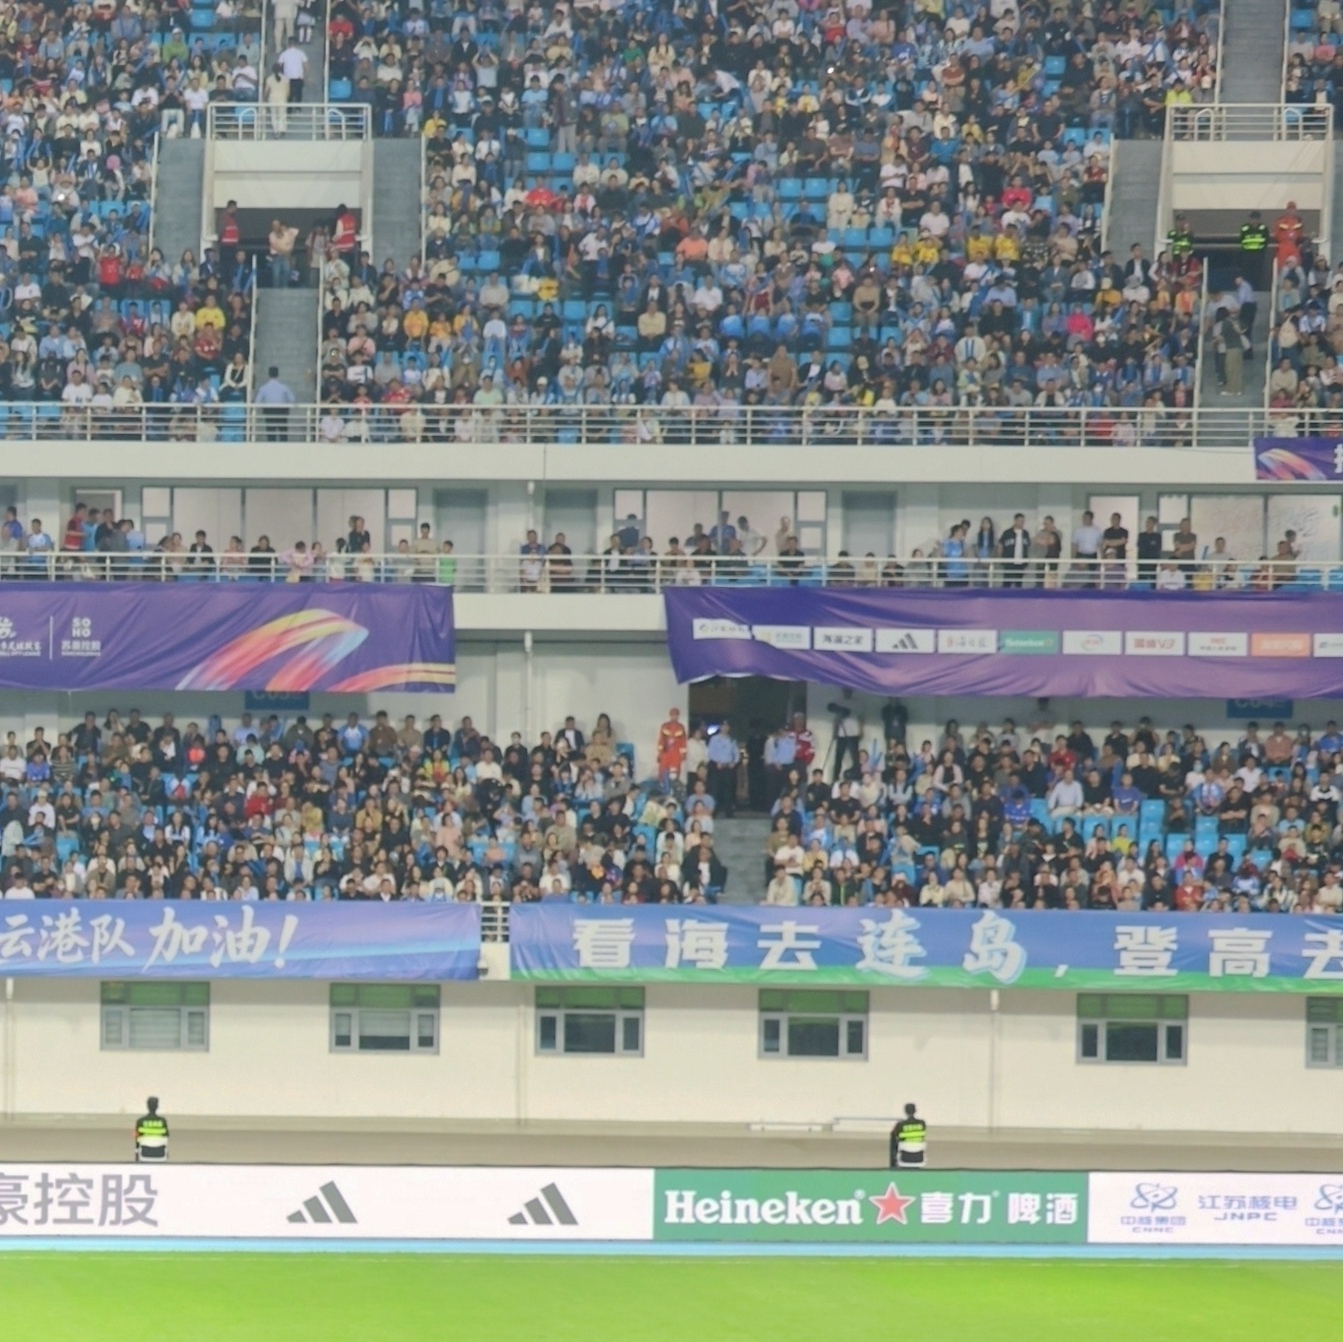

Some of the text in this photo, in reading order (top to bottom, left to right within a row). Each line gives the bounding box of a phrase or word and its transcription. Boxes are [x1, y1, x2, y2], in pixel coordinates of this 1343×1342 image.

[1007, 1192, 1078, 1225] 啤酒
[1198, 1194, 1298, 1211] 江苏核电
[1120, 1215, 1187, 1226] 中核集团
[1214, 1212, 1278, 1221] JNPC
